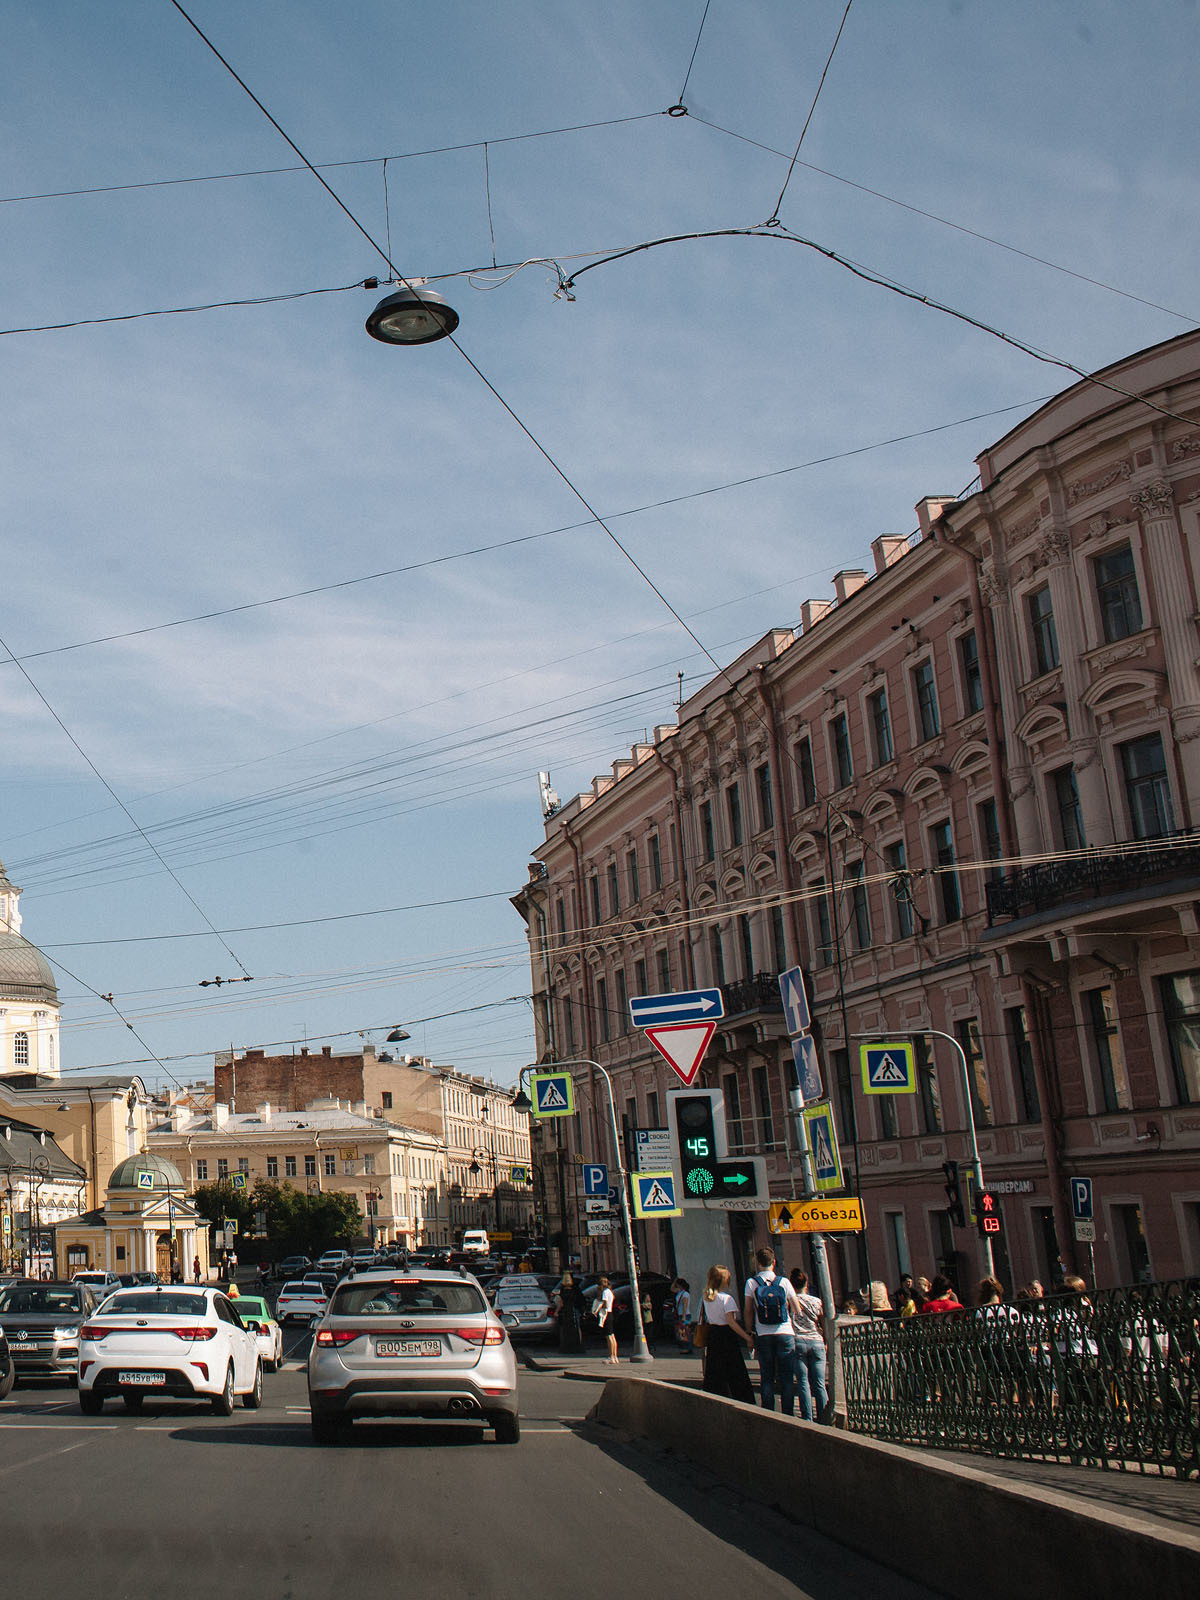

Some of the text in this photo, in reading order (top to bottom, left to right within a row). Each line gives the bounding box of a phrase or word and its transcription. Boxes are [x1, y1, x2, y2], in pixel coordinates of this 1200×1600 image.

[687, 1138, 709, 1156] 45
[589, 1168, 604, 1192] P
[1076, 1183, 1088, 1213] P
[801, 1208, 858, 1221] объезд
